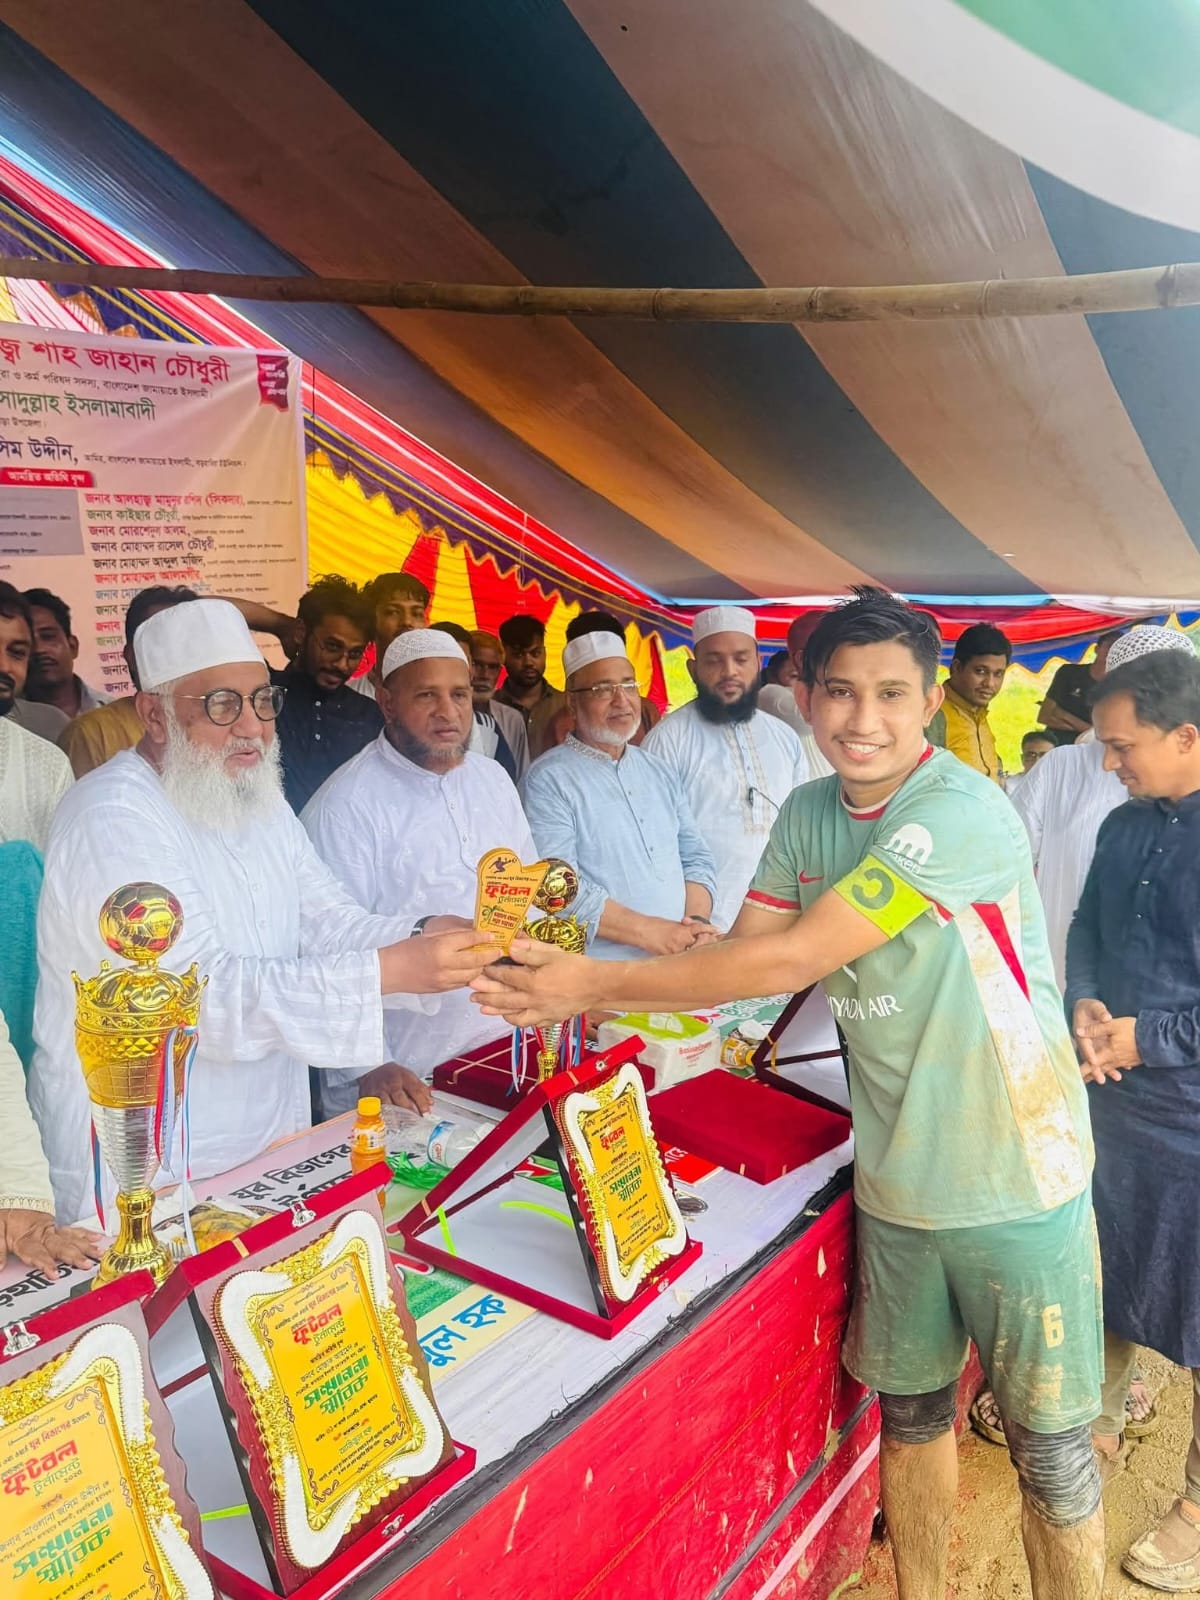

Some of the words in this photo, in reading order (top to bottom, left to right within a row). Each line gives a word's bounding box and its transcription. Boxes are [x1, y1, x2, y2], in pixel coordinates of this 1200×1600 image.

[27, 341, 81, 368] শাহ
[83, 347, 157, 375] জাহান
[166, 352, 231, 385] চৌধুরী
[64, 390, 156, 421] ইসলামাবাদী
[27, 436, 78, 465] উদ্দীন,
[84, 493, 111, 504] জনাব
[86, 509, 113, 520] জনাব
[88, 525, 116, 537] জনাব
[90, 542, 118, 553] জনাব
[93, 559, 117, 569] জনাব
[94, 573, 118, 584] জনাব
[95, 590, 118, 600] জনাব
[95, 605, 118, 615] জনাব
[96, 621, 120, 631] জনাব
[97, 636, 122, 647] জনাব
[102, 665, 128, 676] জনাব
[104, 682, 129, 692] জনাব
[868, 994, 905, 1019] AIR
[228, 1181, 275, 1201] যুব
[451, 1294, 507, 1328] হক
[292, 1303, 343, 1345] ফুটবল
[1041, 1303, 1065, 1349] 6
[2, 1440, 78, 1496] ফুটবল
